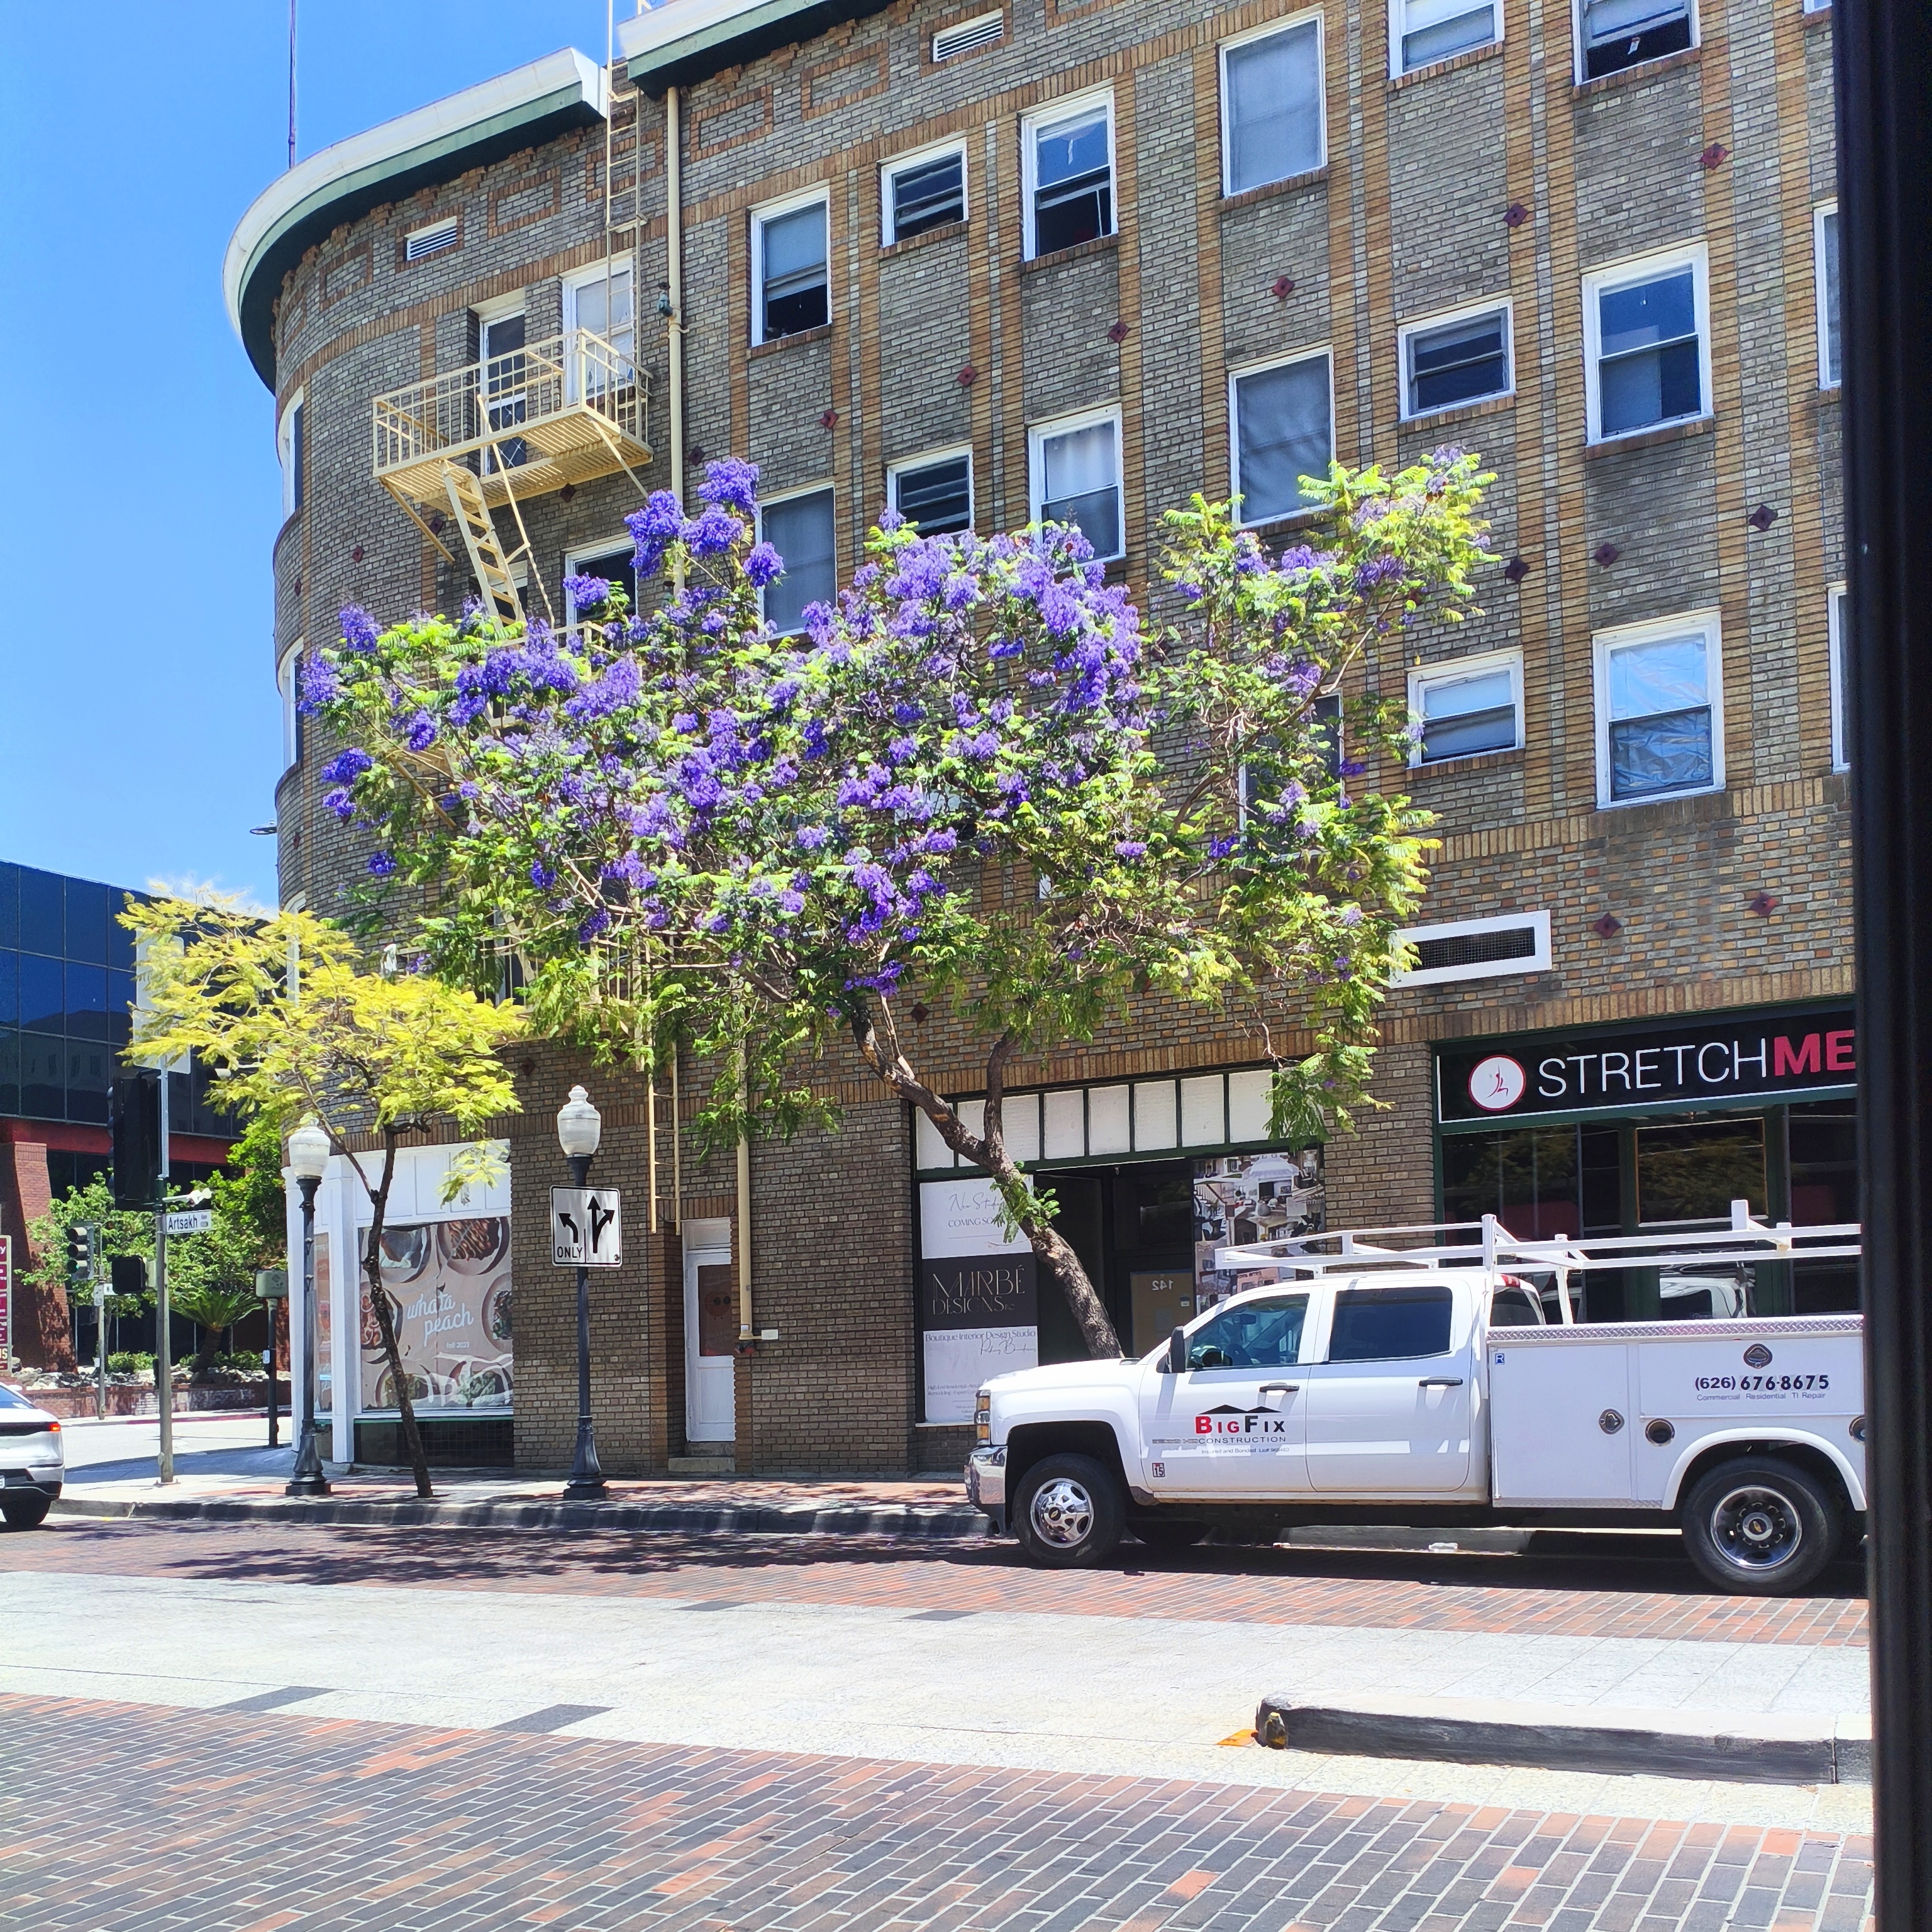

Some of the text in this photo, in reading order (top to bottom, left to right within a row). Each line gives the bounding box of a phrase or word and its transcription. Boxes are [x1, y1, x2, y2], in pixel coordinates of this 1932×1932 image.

[168, 1214, 197, 1231] Artsakh
[948, 1218, 981, 1228] COMING
[557, 1246, 583, 1258] ONLY
[933, 1264, 1025, 1301] MARBÉ
[933, 1296, 1004, 1315] DESIGNS
[425, 1302, 474, 1347] peach
[926, 1328, 1036, 1342] Boutique Interior Design Studio
[1695, 1376, 1736, 1391] (626)
[1199, 1436, 1286, 1445] CONSTRUCTION
[1154, 1467, 1163, 1476] 15
